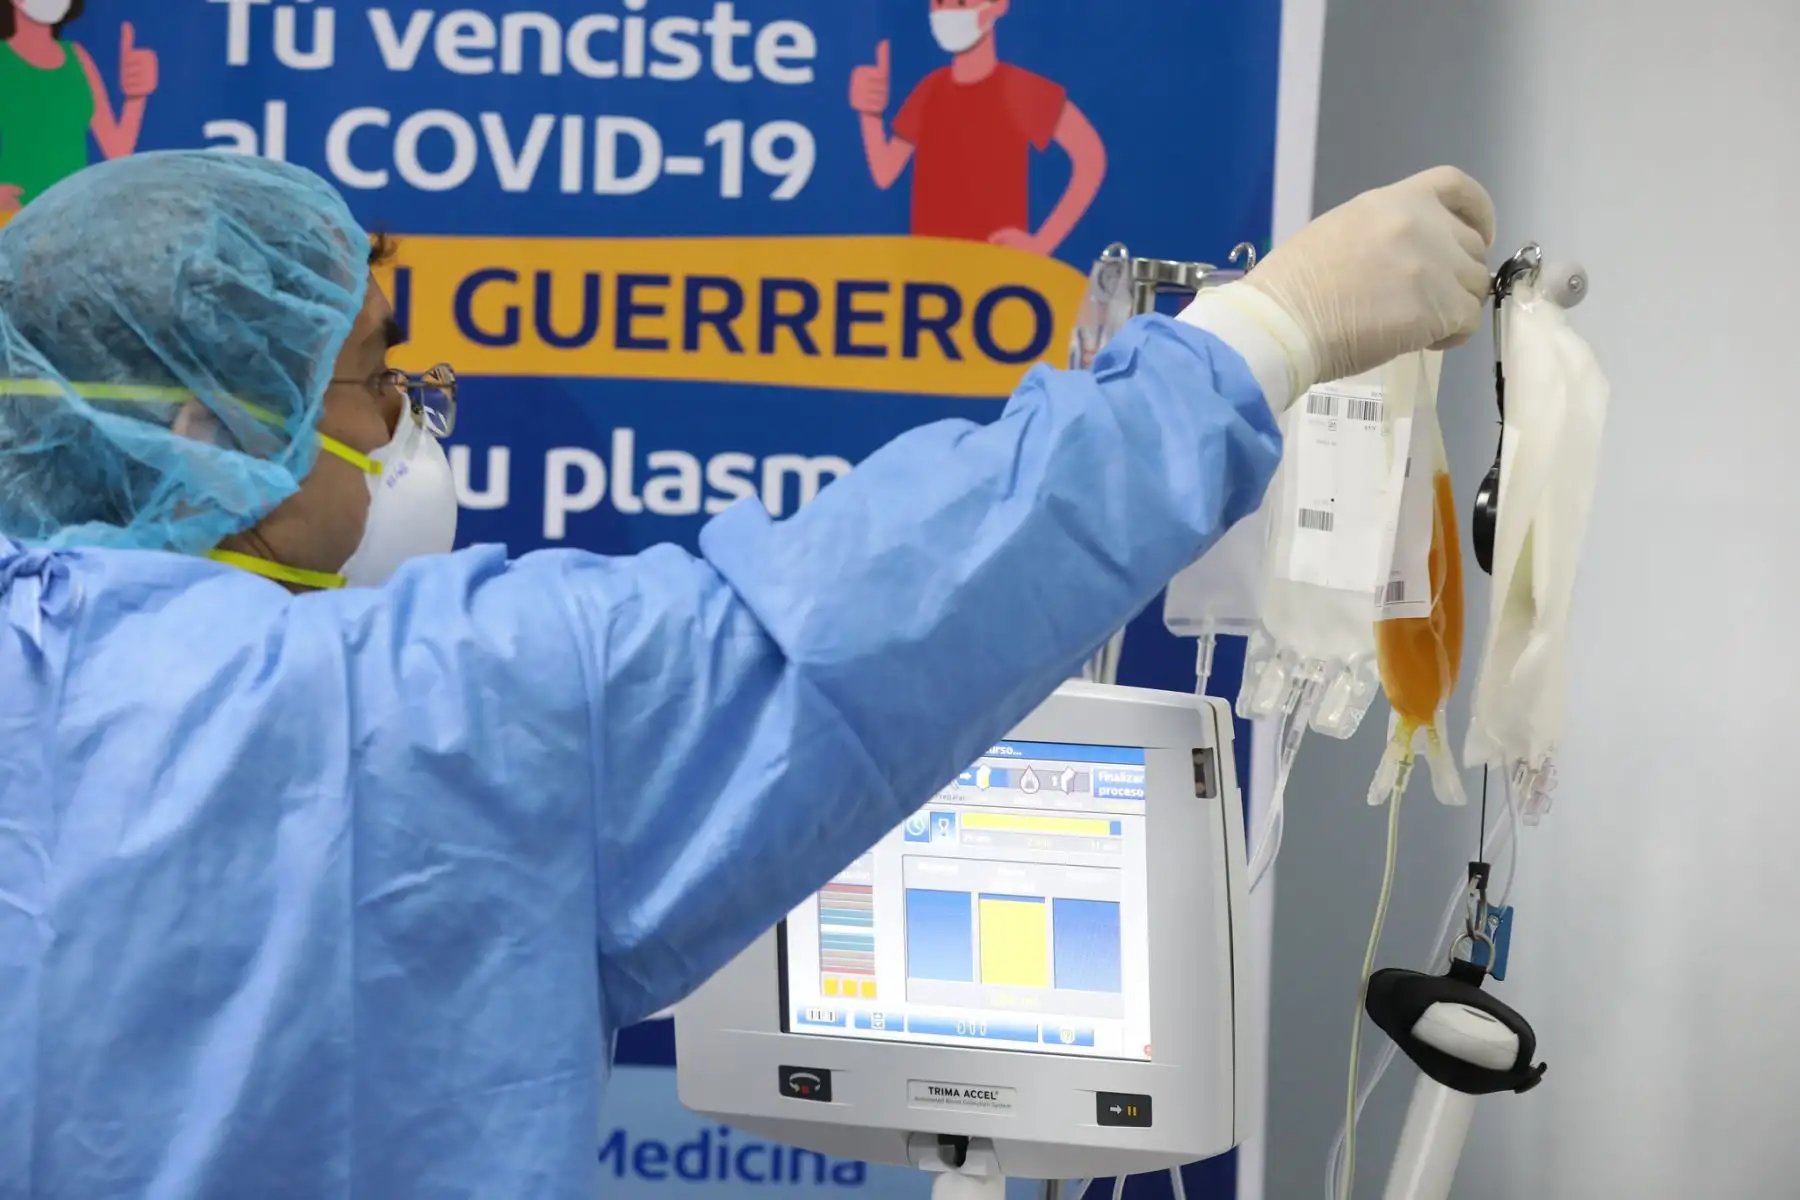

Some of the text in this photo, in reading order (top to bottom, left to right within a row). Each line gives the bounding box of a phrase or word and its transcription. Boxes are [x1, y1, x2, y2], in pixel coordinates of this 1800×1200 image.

[366, 0, 817, 84] venciste
[325, 107, 816, 200] COVID-19
[452, 267, 1054, 364] GUERRERO
[1098, 770, 1145, 785] Finalizar
[1098, 785, 1145, 798] proceso
[928, 1086, 960, 1097] TRIMA
